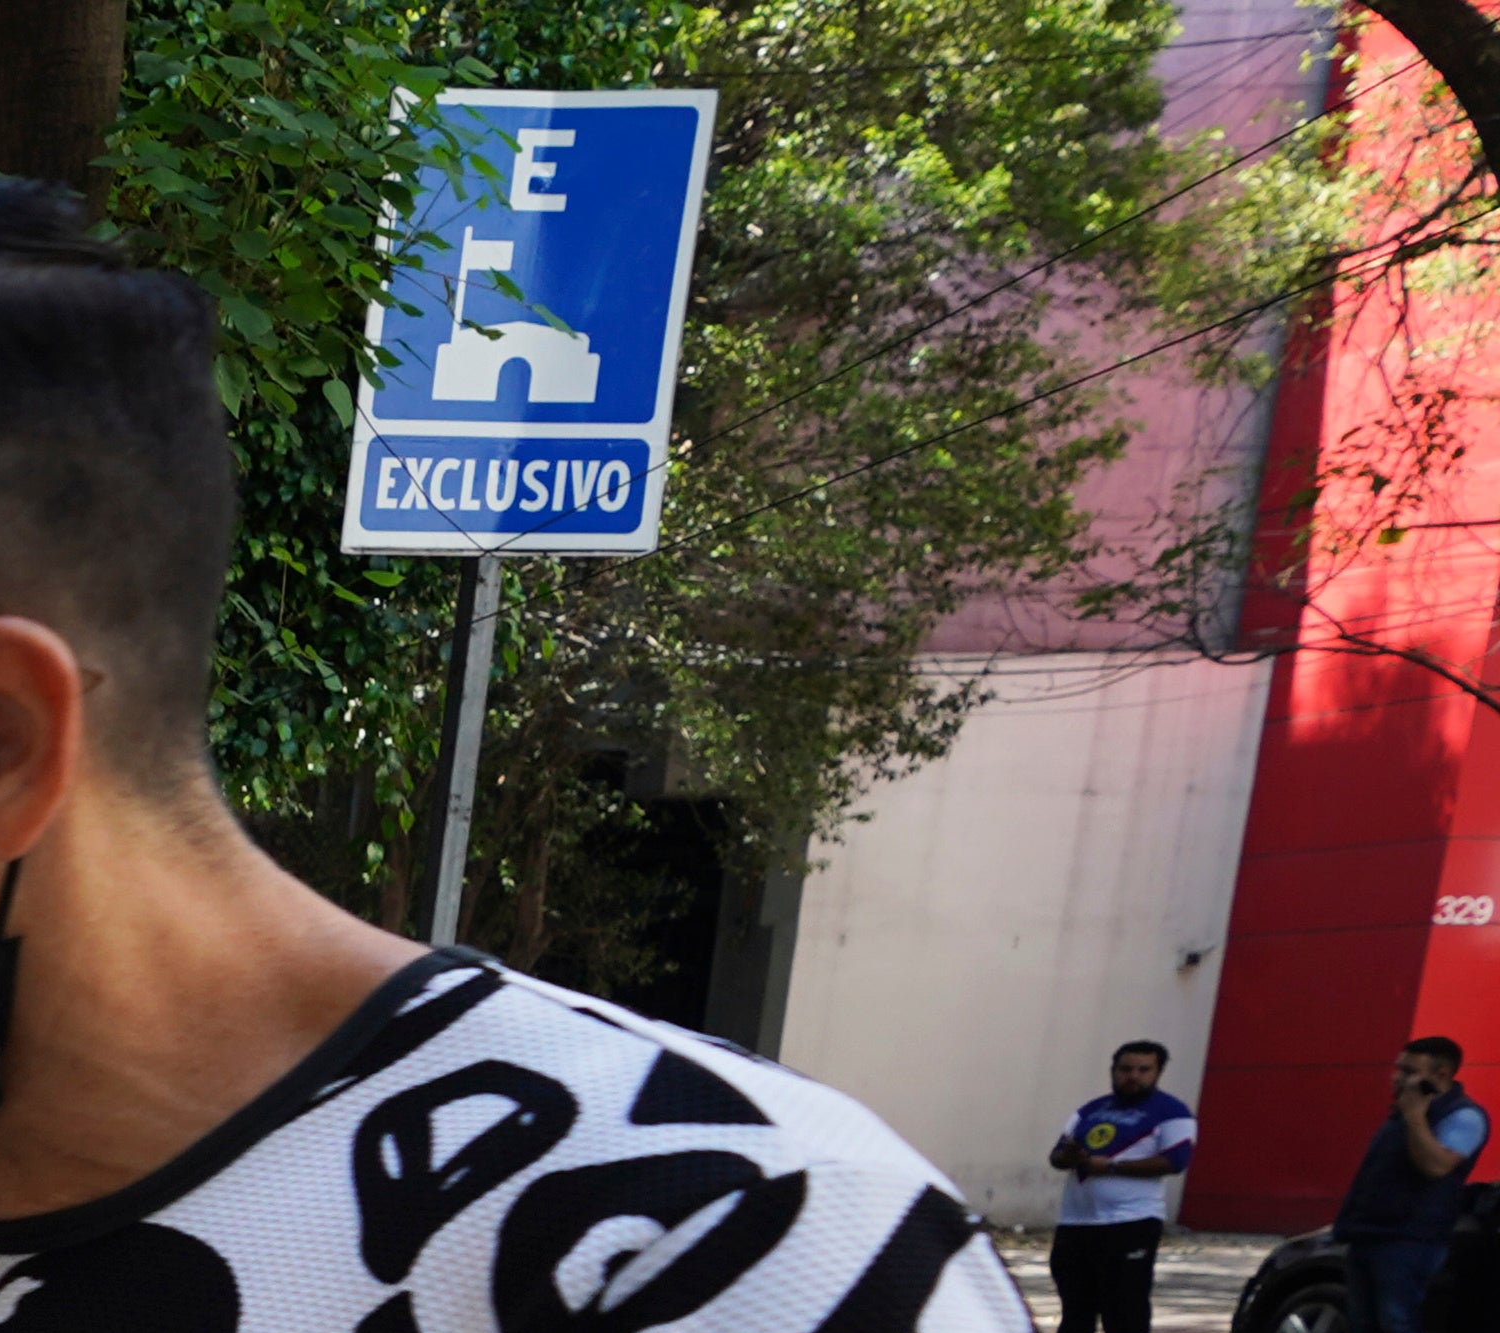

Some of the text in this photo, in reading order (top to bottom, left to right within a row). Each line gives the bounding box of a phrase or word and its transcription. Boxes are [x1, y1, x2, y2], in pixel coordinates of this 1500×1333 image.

[509, 129, 577, 212] E
[376, 457, 631, 512] EXCLUSIVO
[1432, 895, 1494, 926] 329
